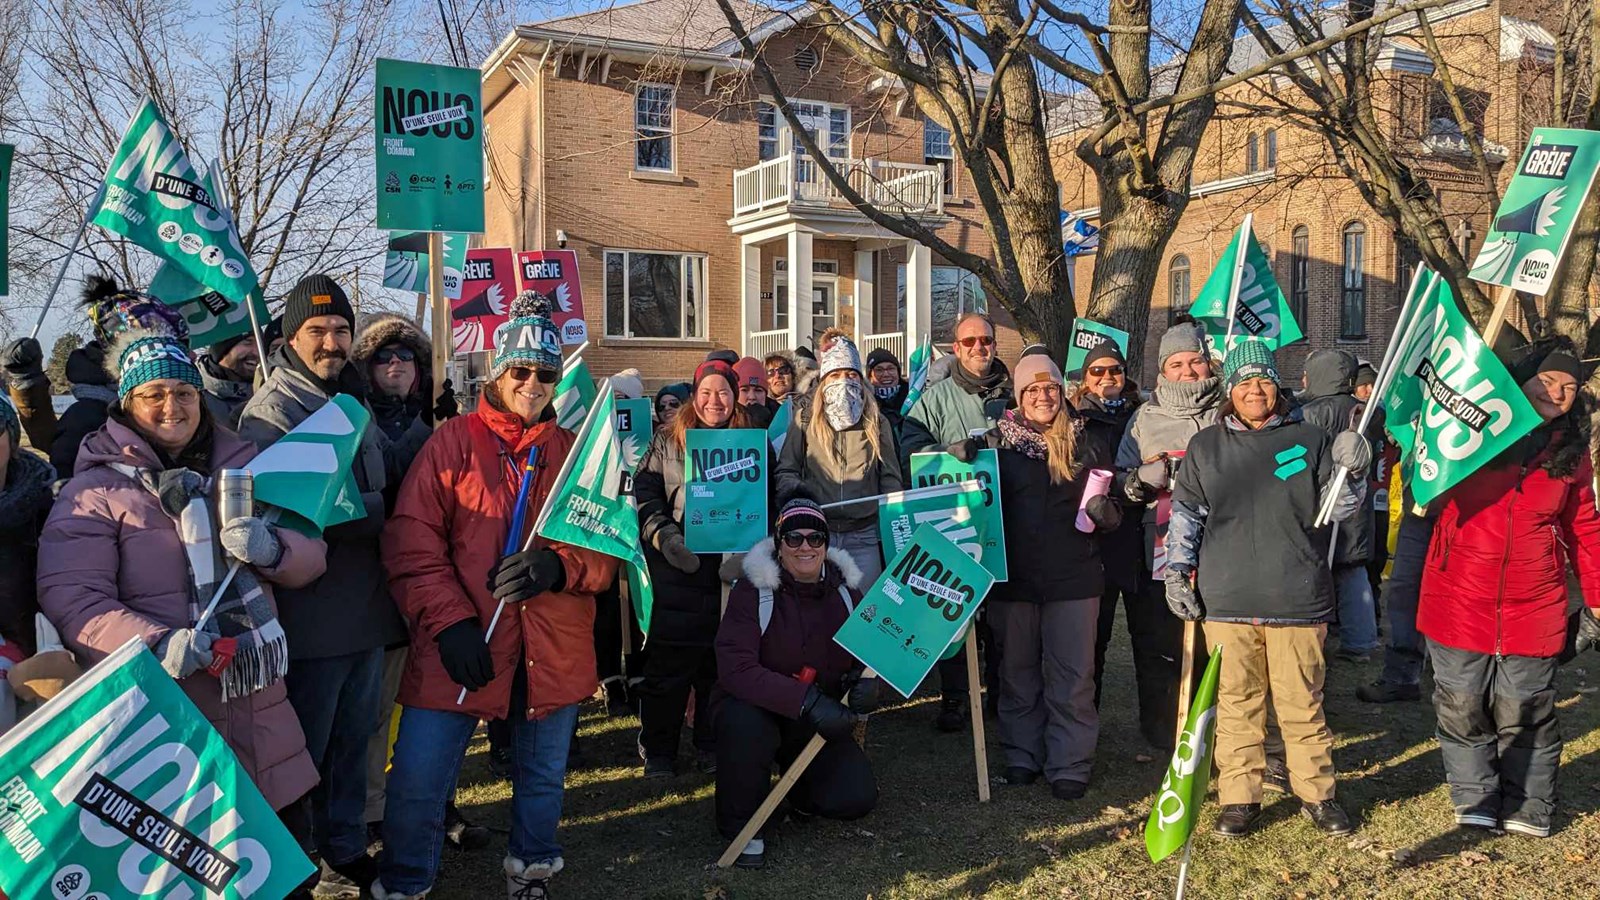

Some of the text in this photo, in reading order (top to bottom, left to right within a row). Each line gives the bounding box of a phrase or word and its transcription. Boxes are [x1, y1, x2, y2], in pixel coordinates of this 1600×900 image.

[383, 86, 475, 140] NOUS
[405, 107, 464, 129] D'UNE SEULE VOIX
[383, 138, 404, 147] FRONT
[1525, 145, 1571, 176] GRÈVE
[155, 176, 193, 198] D'UNE
[463, 259, 492, 279] RÈVE
[525, 259, 561, 279] GRÈVE
[1521, 259, 1549, 279] NOUS
[565, 325, 584, 336] NOUS
[1241, 311, 1262, 332] VOIX
[121, 343, 192, 374] OUS
[1432, 380, 1457, 408] SEULE
[1456, 401, 1486, 428] VOIX
[692, 448, 761, 482] NOUS
[566, 493, 608, 521] FRONT
[565, 510, 620, 539] COMMUN
[891, 543, 975, 621] NOUS
[910, 577, 928, 589] D'UNE
[930, 583, 947, 596] SEULE
[0, 775, 48, 824] FRONT
[83, 782, 230, 887] D'UNE SEULE VOIX
[56, 880, 71, 897] CSN
